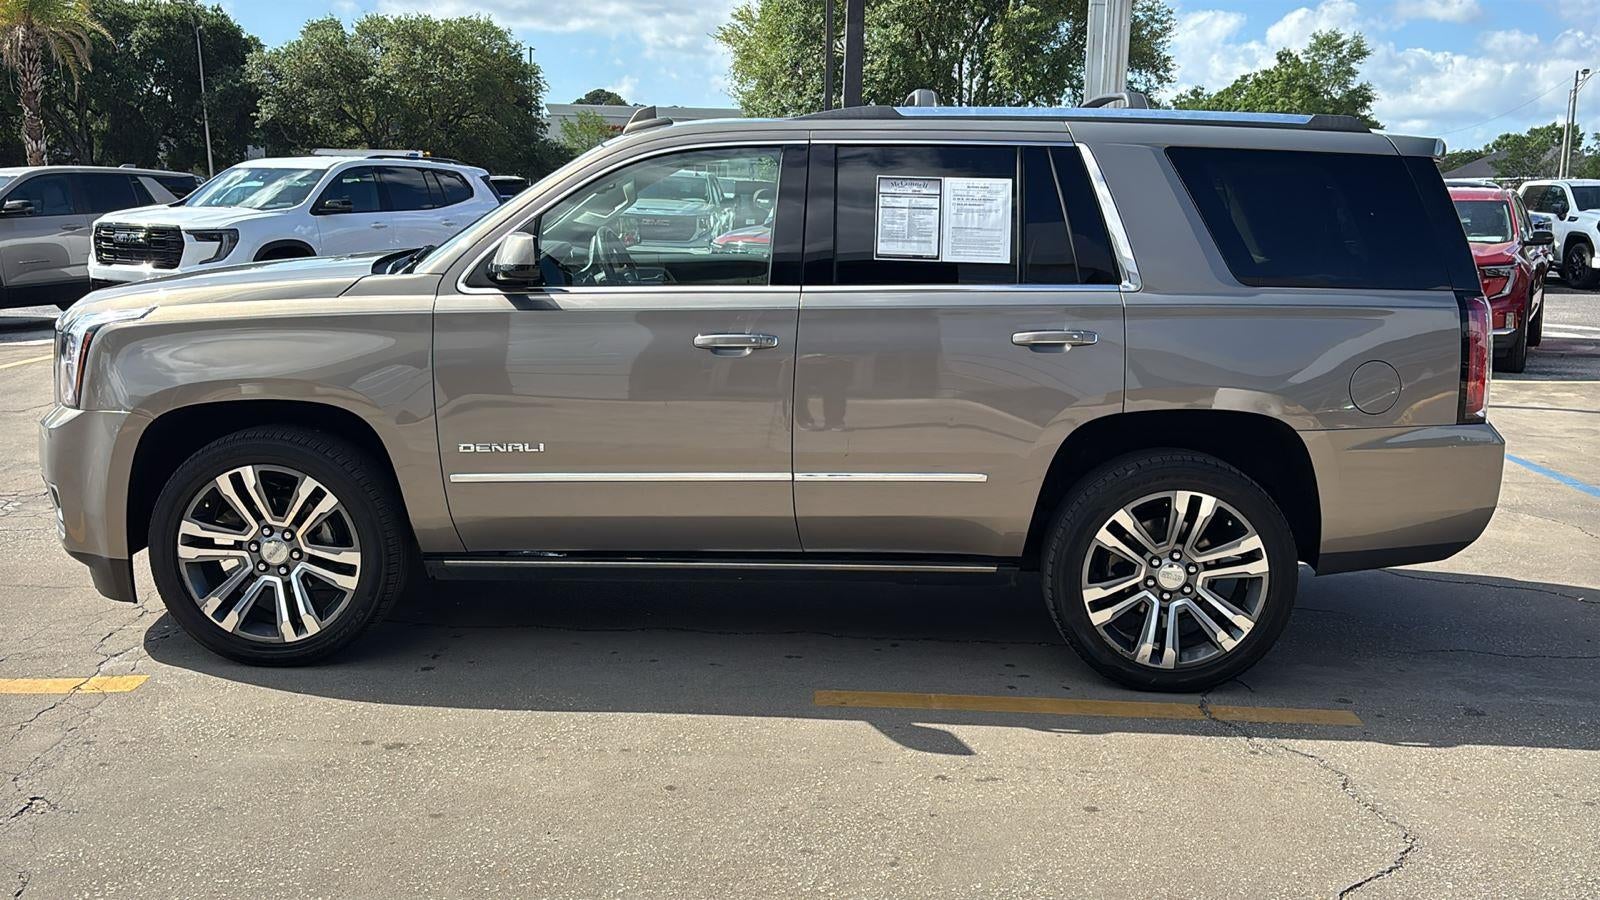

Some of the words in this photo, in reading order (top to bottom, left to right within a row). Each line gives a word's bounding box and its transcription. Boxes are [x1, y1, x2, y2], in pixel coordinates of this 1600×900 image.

[890, 180, 929, 189] McConnell
[113, 233, 145, 244] GMC
[458, 443, 545, 453] DENALI
